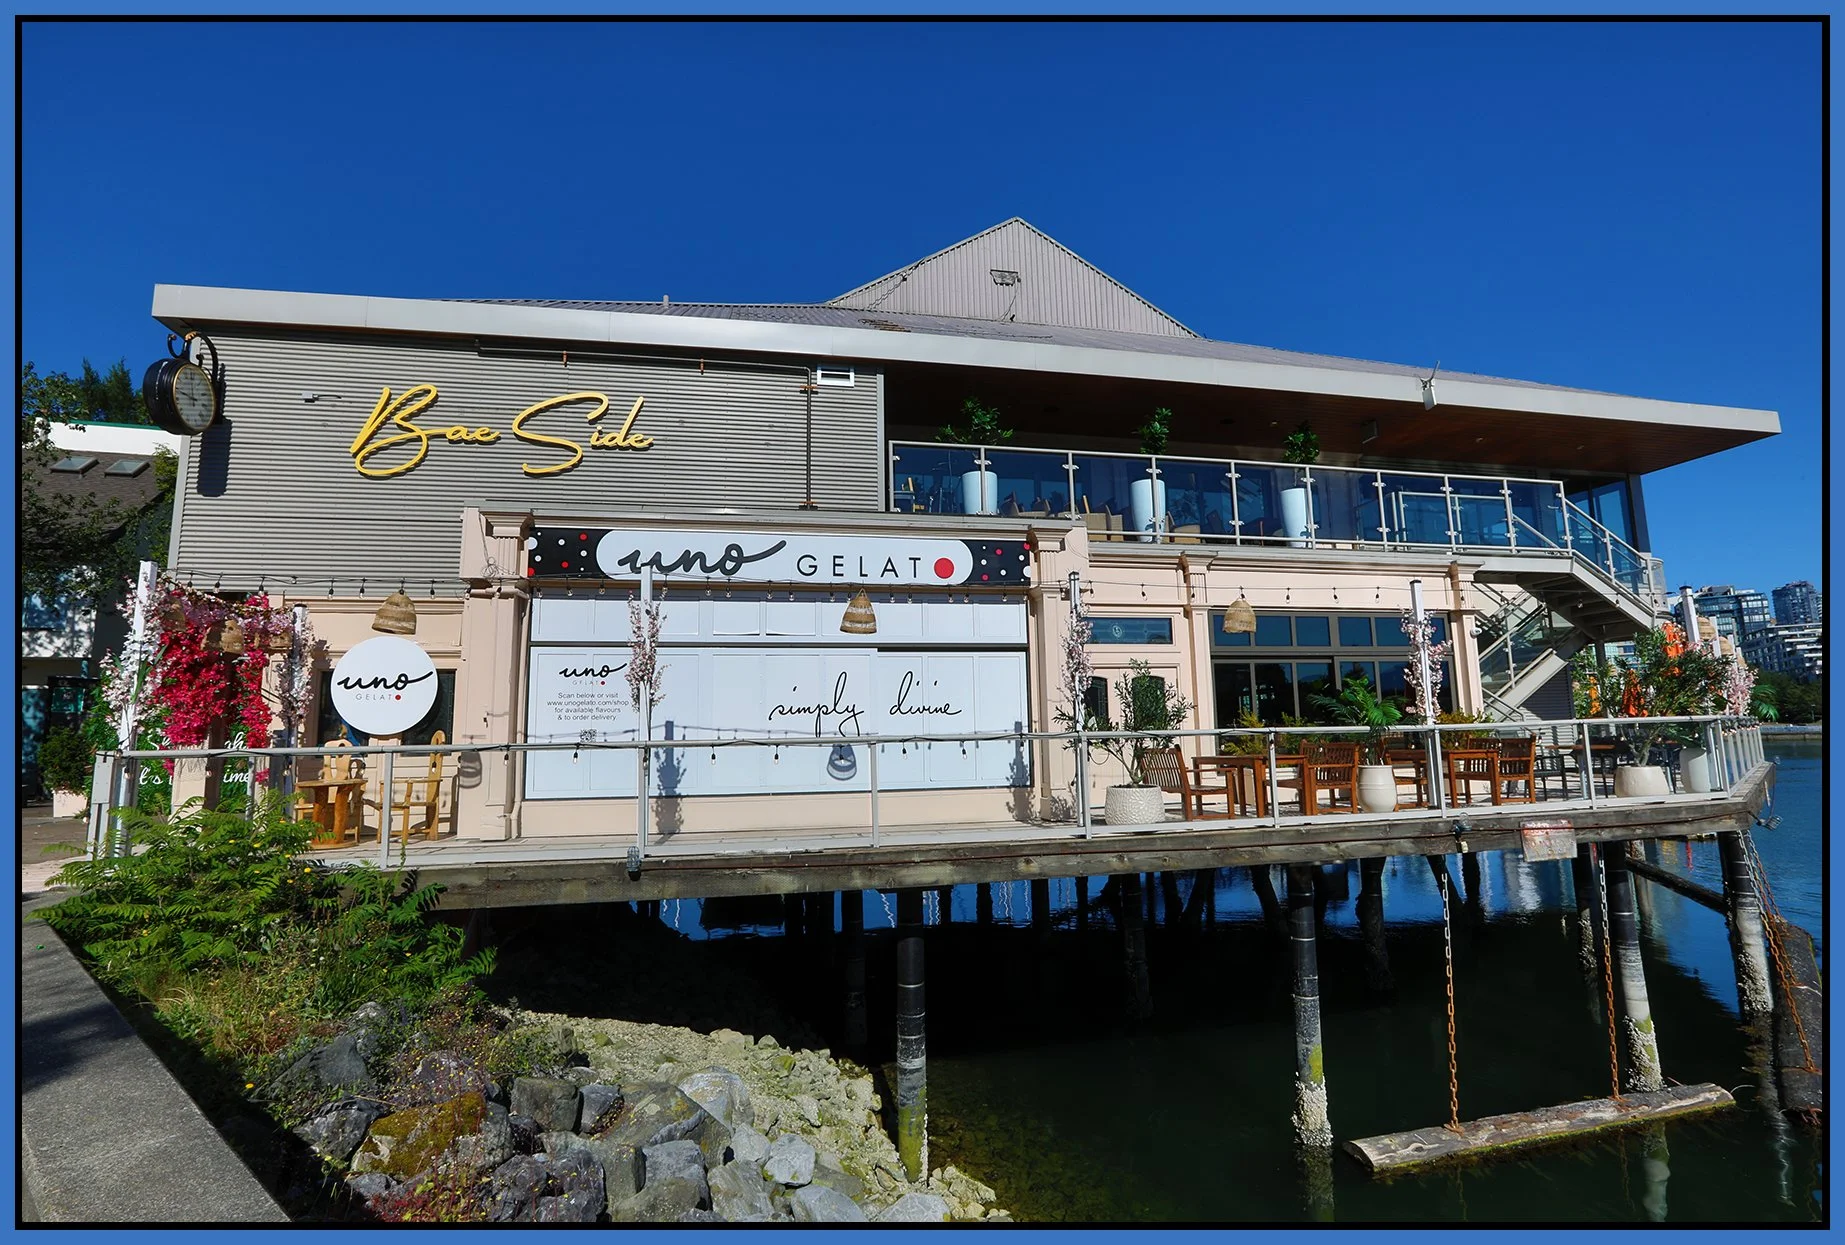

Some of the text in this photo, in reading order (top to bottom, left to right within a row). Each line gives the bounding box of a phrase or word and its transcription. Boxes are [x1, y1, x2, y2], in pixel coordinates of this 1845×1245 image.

[350, 384, 654, 476] Bae Side
[617, 540, 787, 575] uno
[336, 673, 434, 690] uno
[559, 663, 628, 678] uno
[554, 706, 563, 714] for
[595, 706, 622, 714] flavours
[768, 670, 963, 738] simply divine
